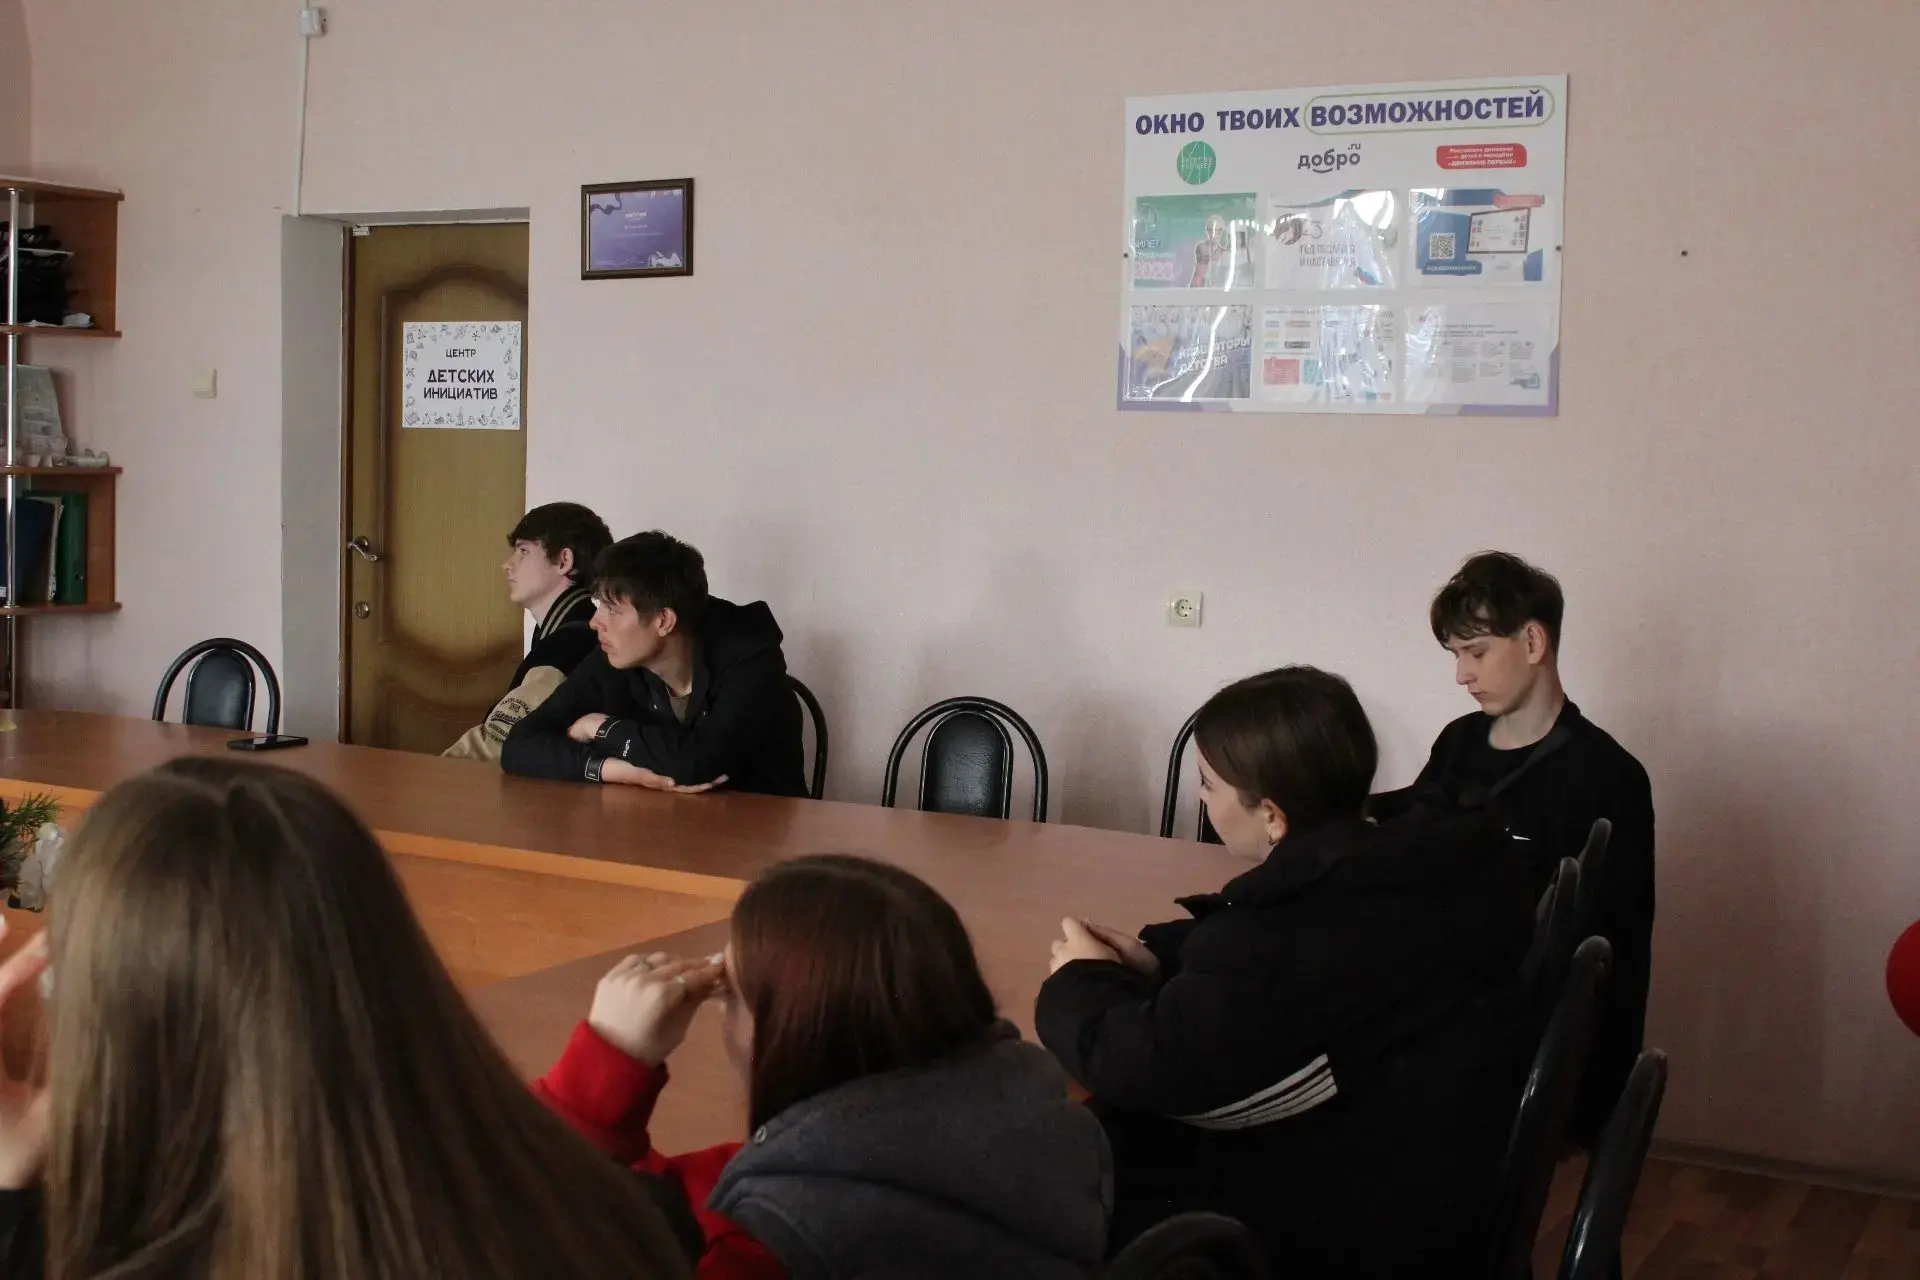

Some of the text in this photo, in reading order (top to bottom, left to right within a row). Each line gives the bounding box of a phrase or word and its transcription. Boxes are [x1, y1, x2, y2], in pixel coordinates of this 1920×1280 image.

[1135, 89, 1545, 135] ОКНО ТВОИХ ВОЗМОЖНОСТЕЙ
[1347, 142, 1361, 150] .ru
[1297, 148, 1361, 170] добро
[445, 348, 477, 359] ЦЕНТР
[427, 369, 495, 383] ДЕТСКИХ
[423, 387, 498, 401] ИНИЦИАТИВ
